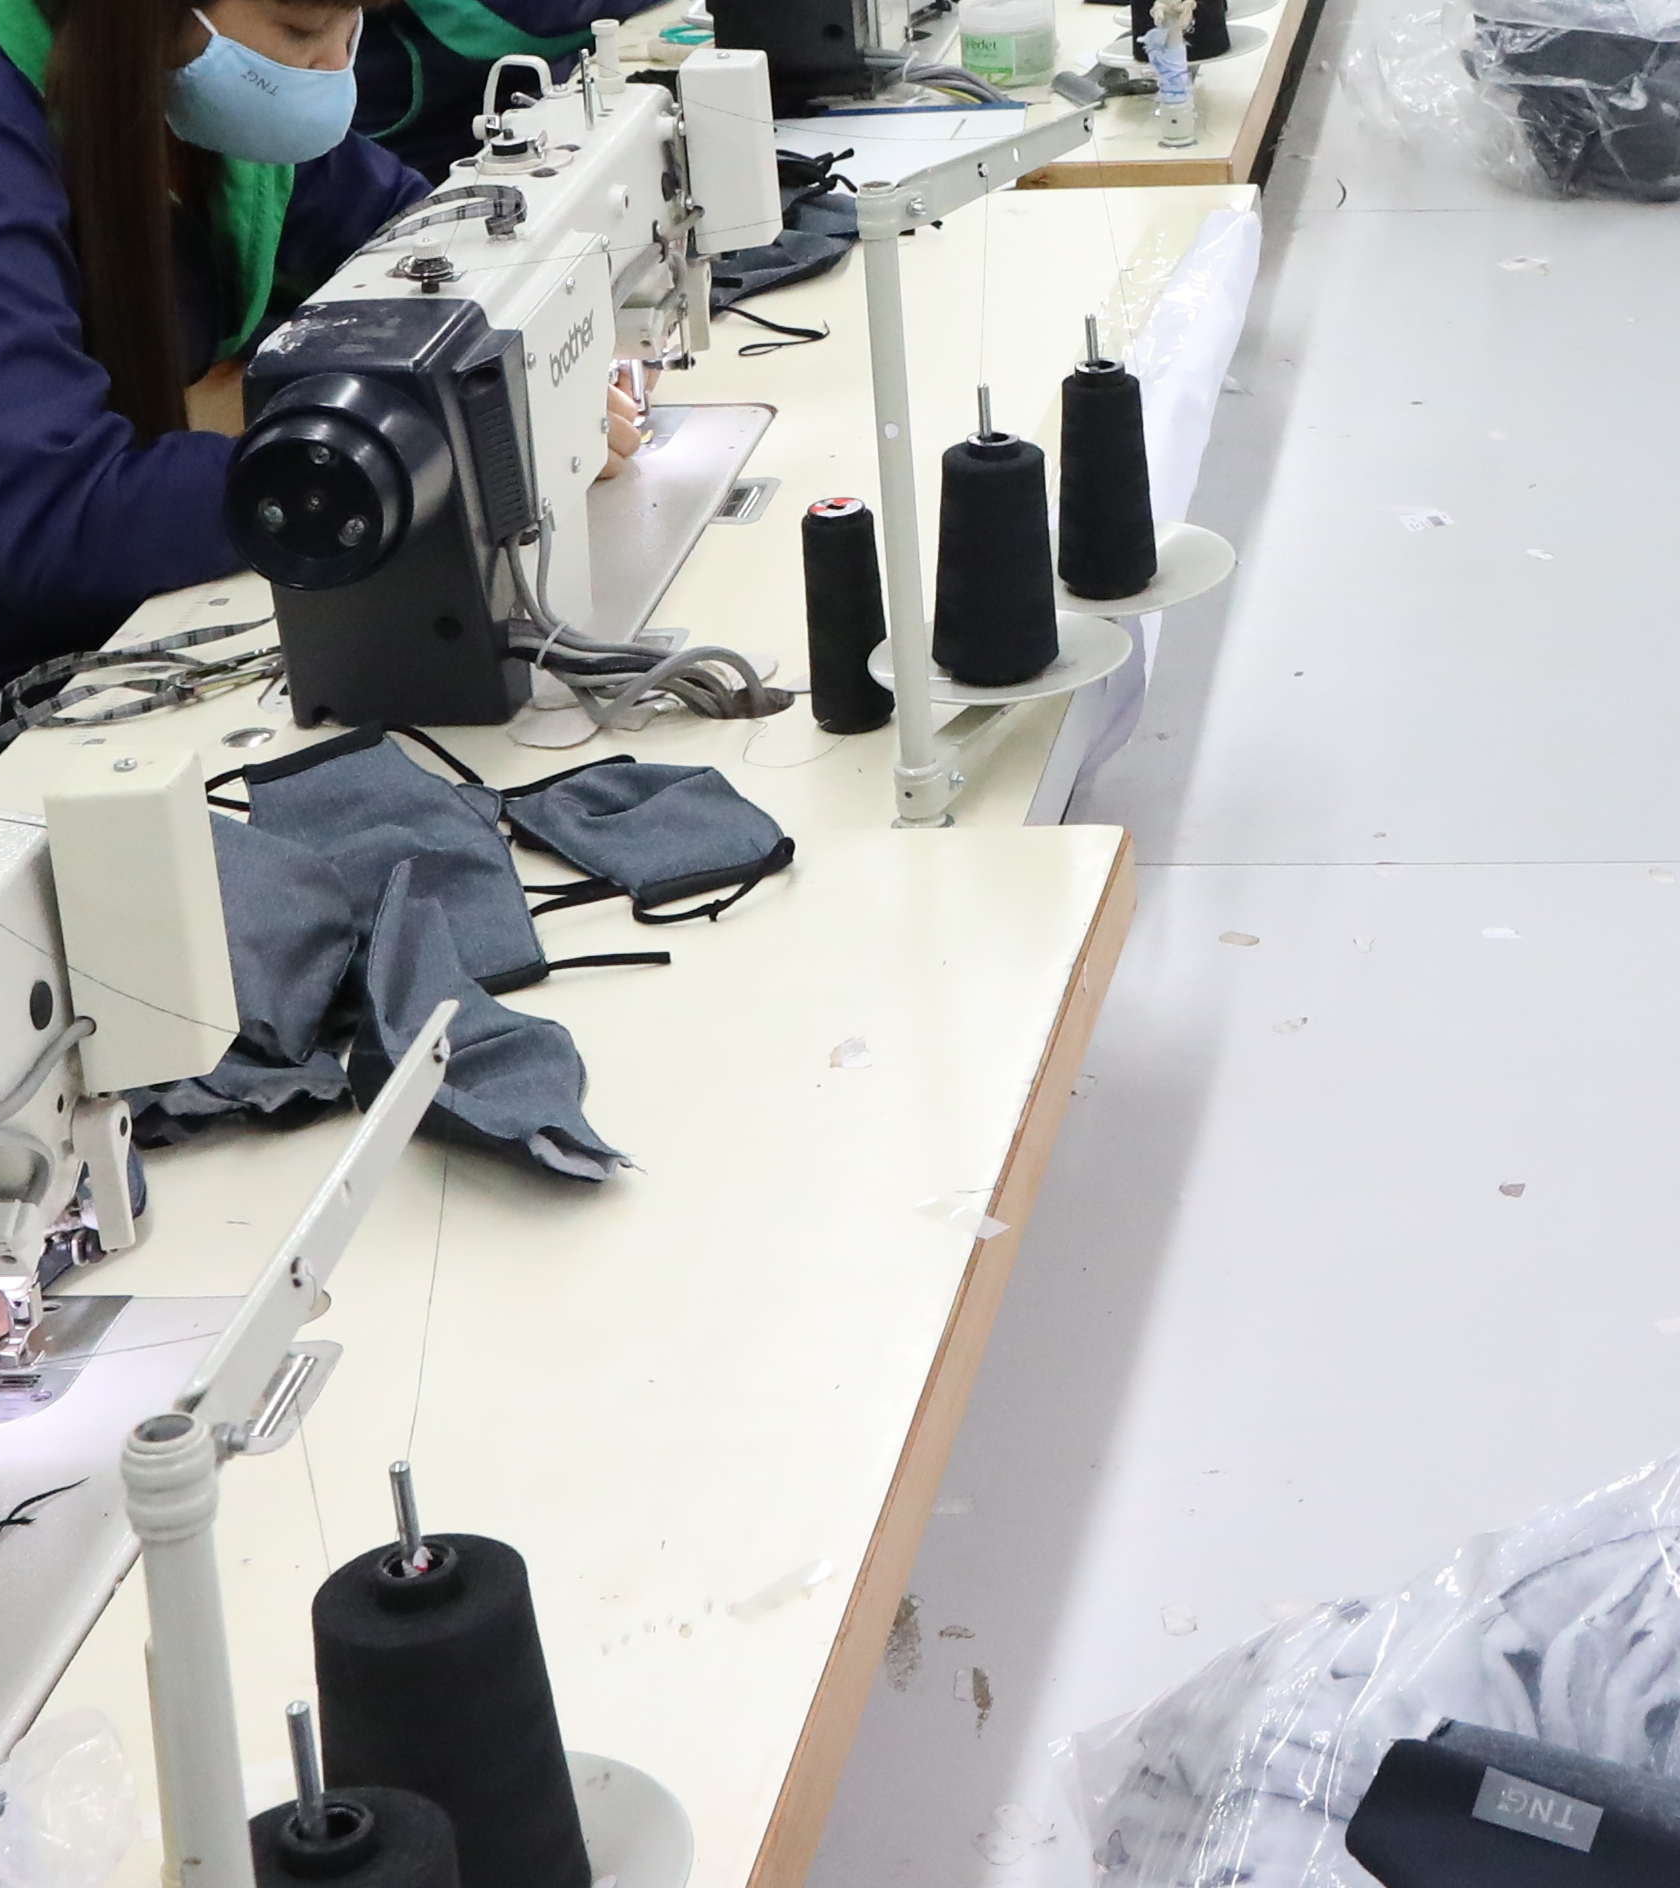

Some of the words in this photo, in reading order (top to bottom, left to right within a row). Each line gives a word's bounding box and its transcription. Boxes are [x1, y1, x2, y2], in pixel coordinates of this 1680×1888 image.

[245, 69, 279, 96] TNG
[549, 308, 594, 388] brother
[1505, 1787, 1575, 1831] TNG
